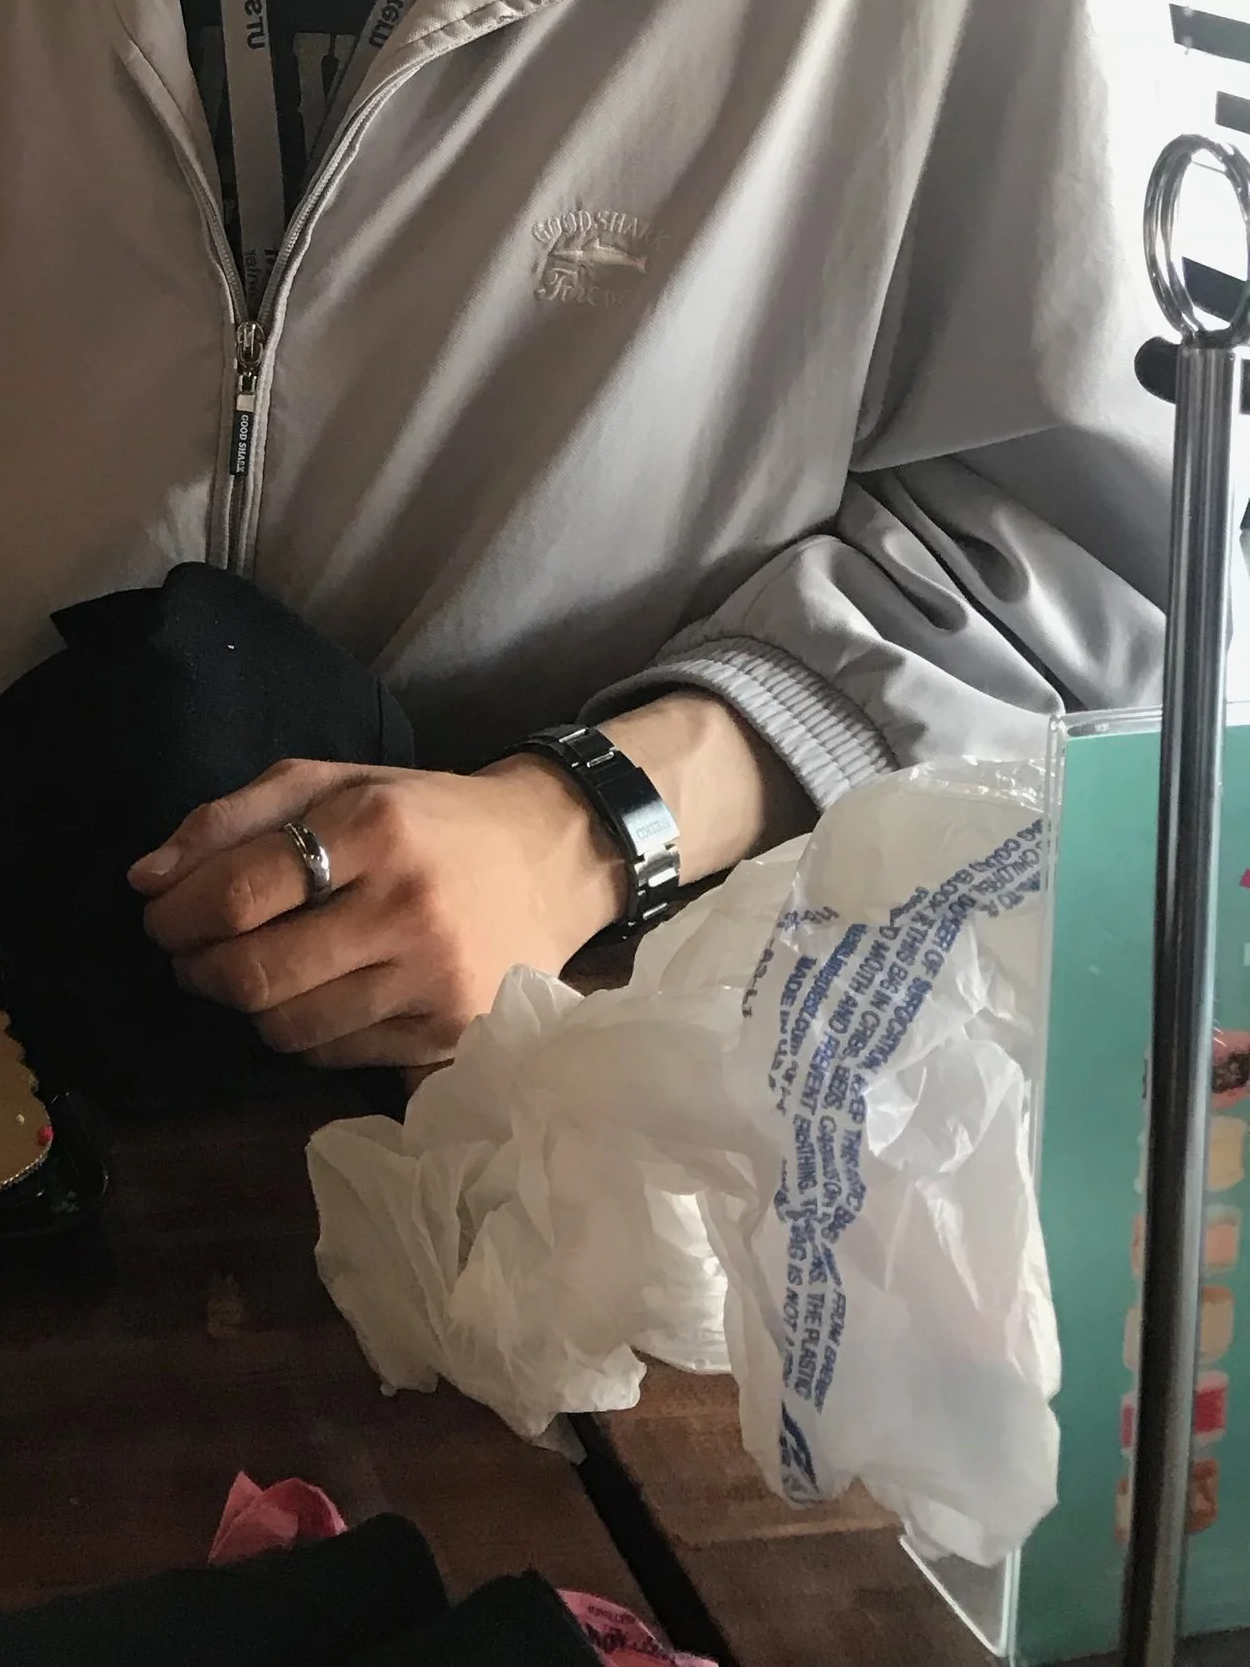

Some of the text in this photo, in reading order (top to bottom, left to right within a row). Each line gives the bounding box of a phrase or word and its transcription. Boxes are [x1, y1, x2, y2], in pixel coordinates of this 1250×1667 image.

[240, 414, 249, 442] GOOD
[848, 938, 891, 996] MOUTH
[828, 989, 859, 1035] AND
[804, 1292, 826, 1328] THE
[793, 1327, 821, 1401] PLASTIC
